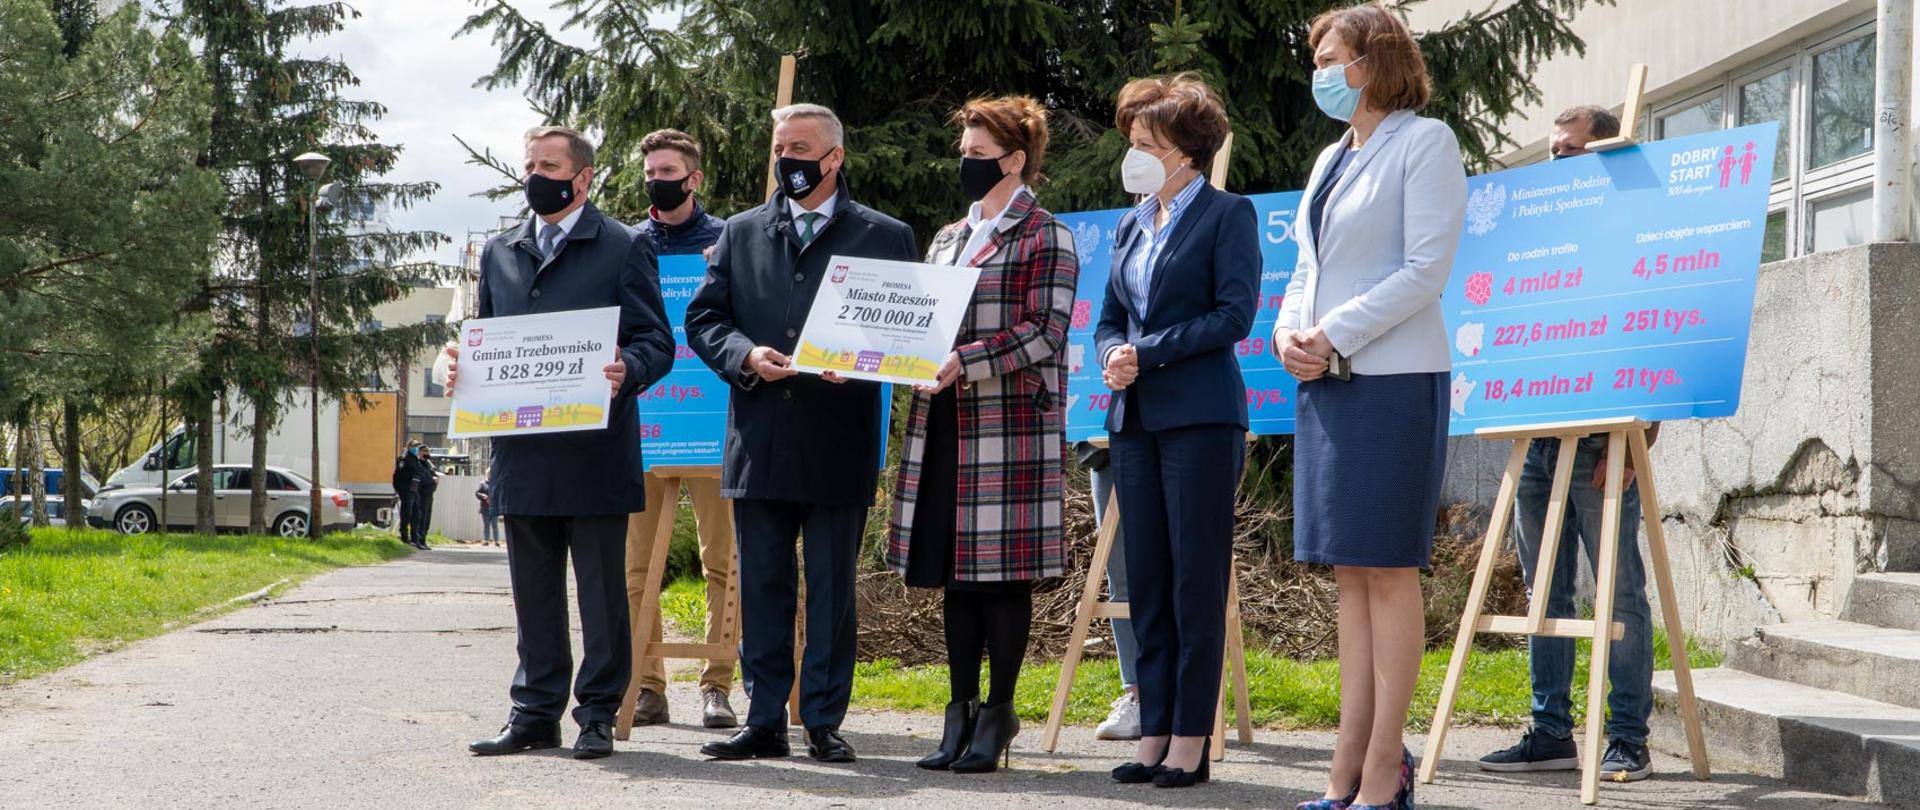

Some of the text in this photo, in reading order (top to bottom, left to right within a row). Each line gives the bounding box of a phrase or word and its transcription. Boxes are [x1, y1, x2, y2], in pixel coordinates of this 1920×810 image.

[1672, 147, 1719, 166] DOBRY
[1669, 165, 1712, 183] START
[1512, 176, 1611, 201] Ministerstwo Rodziny
[1512, 195, 1604, 219] i Polityki Społecznej
[1636, 219, 1751, 243] Dzieci objęte wsparciem
[1508, 252, 1519, 262] Do
[1521, 246, 1549, 260] rodzin
[1503, 248, 1720, 295] 4 mld zł 4,5 mln
[662, 288, 691, 300] olityki
[882, 281, 911, 290] PROMESA
[846, 288, 939, 307] Miasto Rzeszów
[838, 305, 849, 319] 2
[852, 306, 881, 323] 700
[884, 309, 914, 326] 000
[916, 312, 934, 328] zł
[1493, 308, 1706, 347] 227,6 mln zł 251 tys.
[472, 340, 602, 361] Gmina Trzebownisko
[1239, 338, 1264, 356] 59
[486, 357, 584, 381] 1 828 299 zł
[671, 384, 704, 402] tys.
[1485, 368, 1683, 402] 18,4 mln zł 21 tys.
[1247, 388, 1288, 409] tys.
